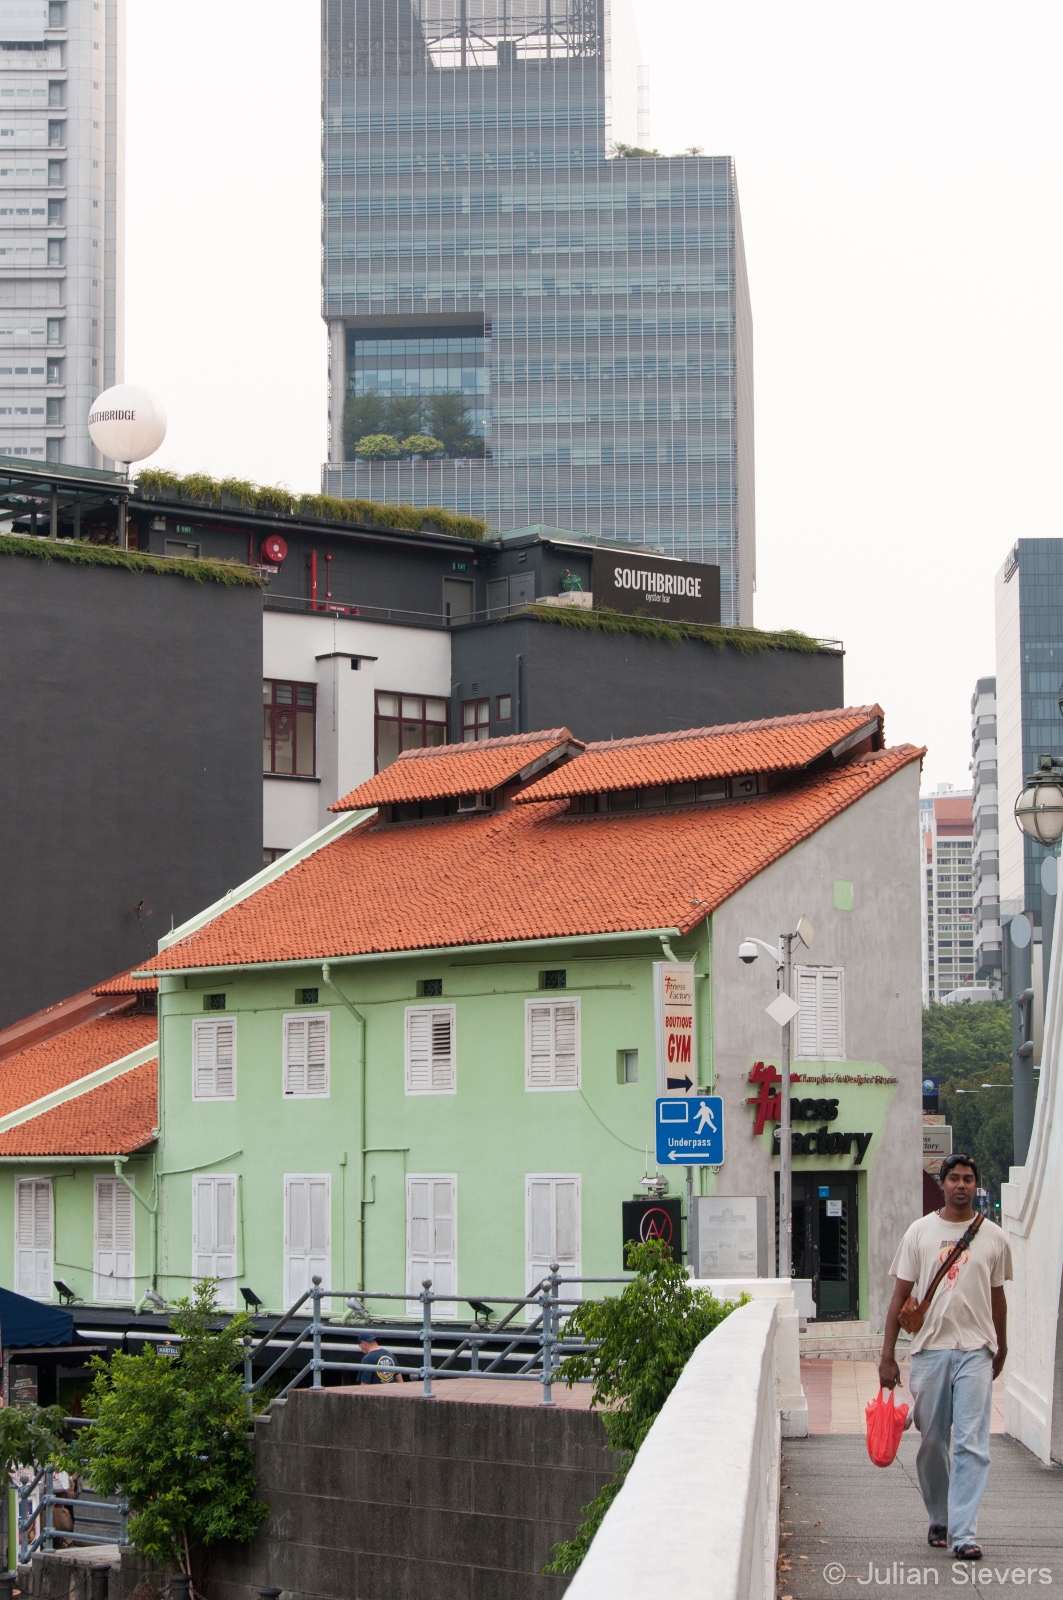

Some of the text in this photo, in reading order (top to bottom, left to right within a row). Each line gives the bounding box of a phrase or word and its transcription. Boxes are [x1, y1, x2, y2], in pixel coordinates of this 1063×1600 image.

[88, 410, 136, 425] SOUTHBRIDGE
[614, 567, 702, 597] SOUTHBRIDGE
[645, 592, 671, 603] oyster bar
[669, 991, 692, 1002] Factory
[665, 1016, 692, 1029] BOUTIQUE
[667, 1033, 691, 1063] GYM
[668, 1137, 711, 1149] Underpass
